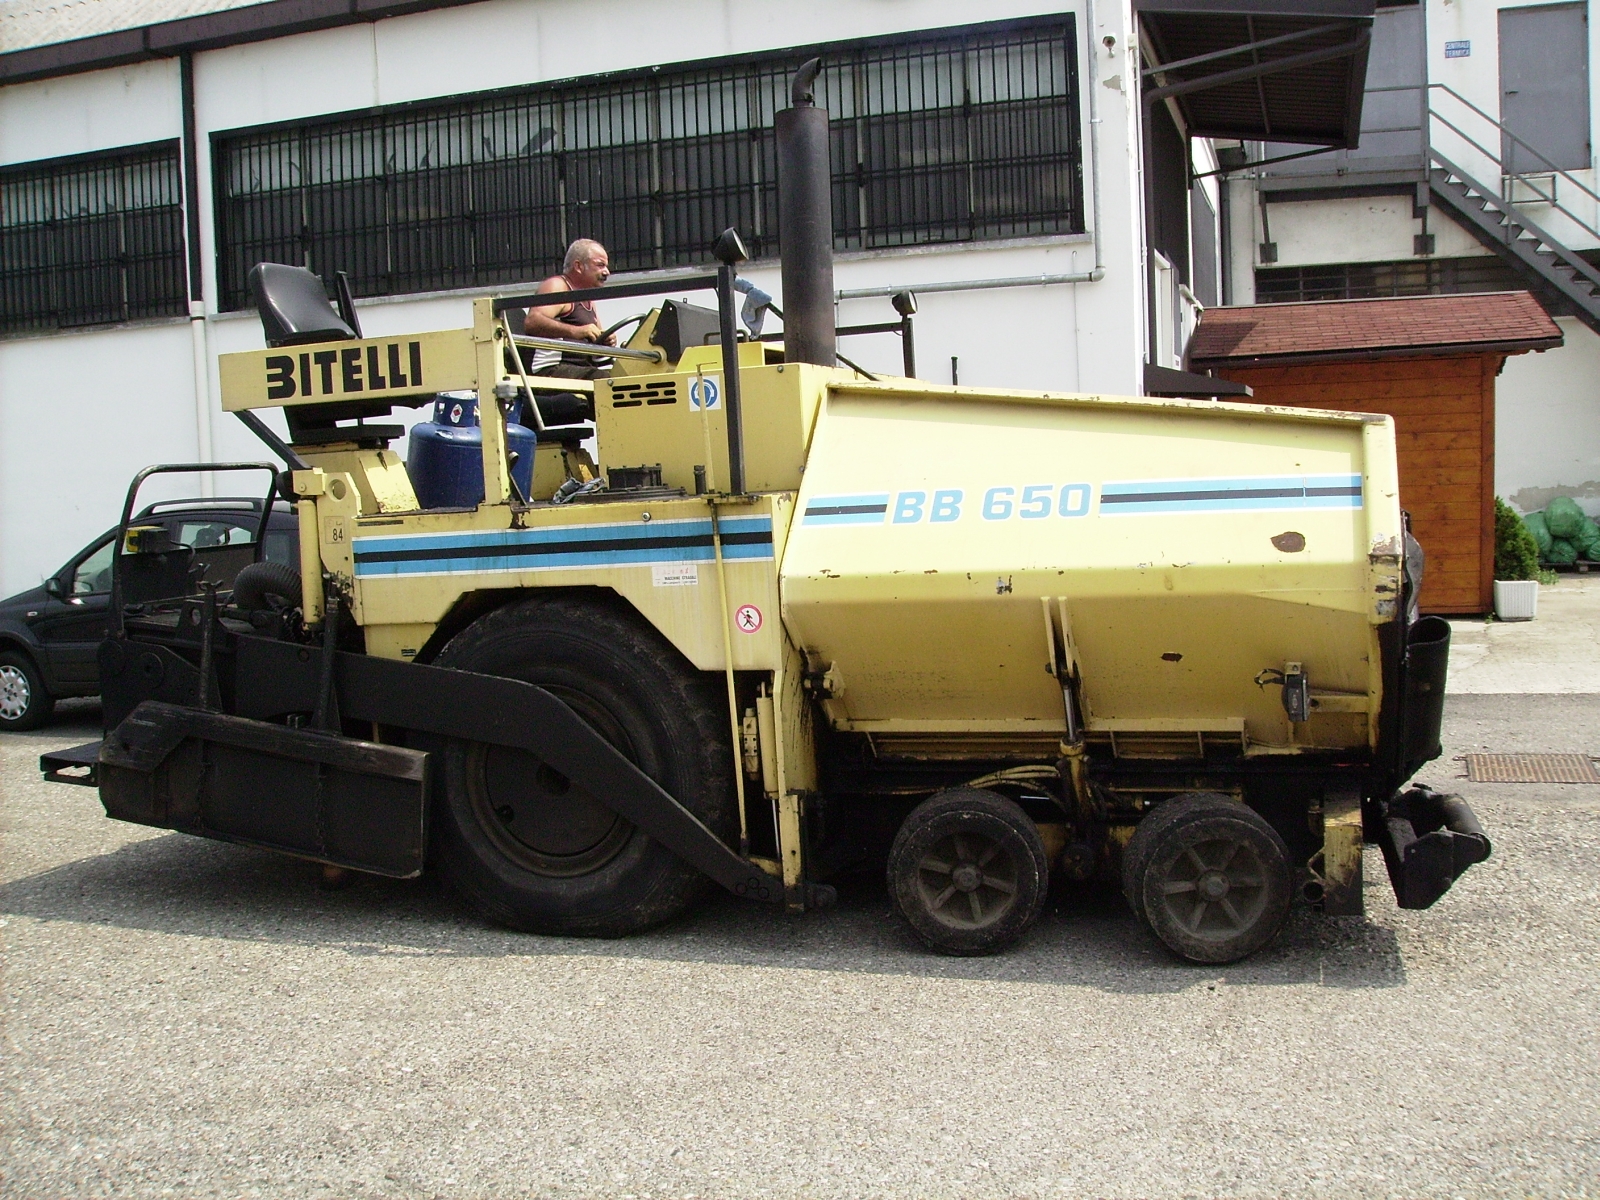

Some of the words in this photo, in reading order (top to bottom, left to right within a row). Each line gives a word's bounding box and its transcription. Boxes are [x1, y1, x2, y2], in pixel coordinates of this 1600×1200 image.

[266, 341, 423, 400] BITELLI
[892, 489, 964, 525] BB
[982, 483, 1092, 521] 650
[332, 528, 344, 542] 84
